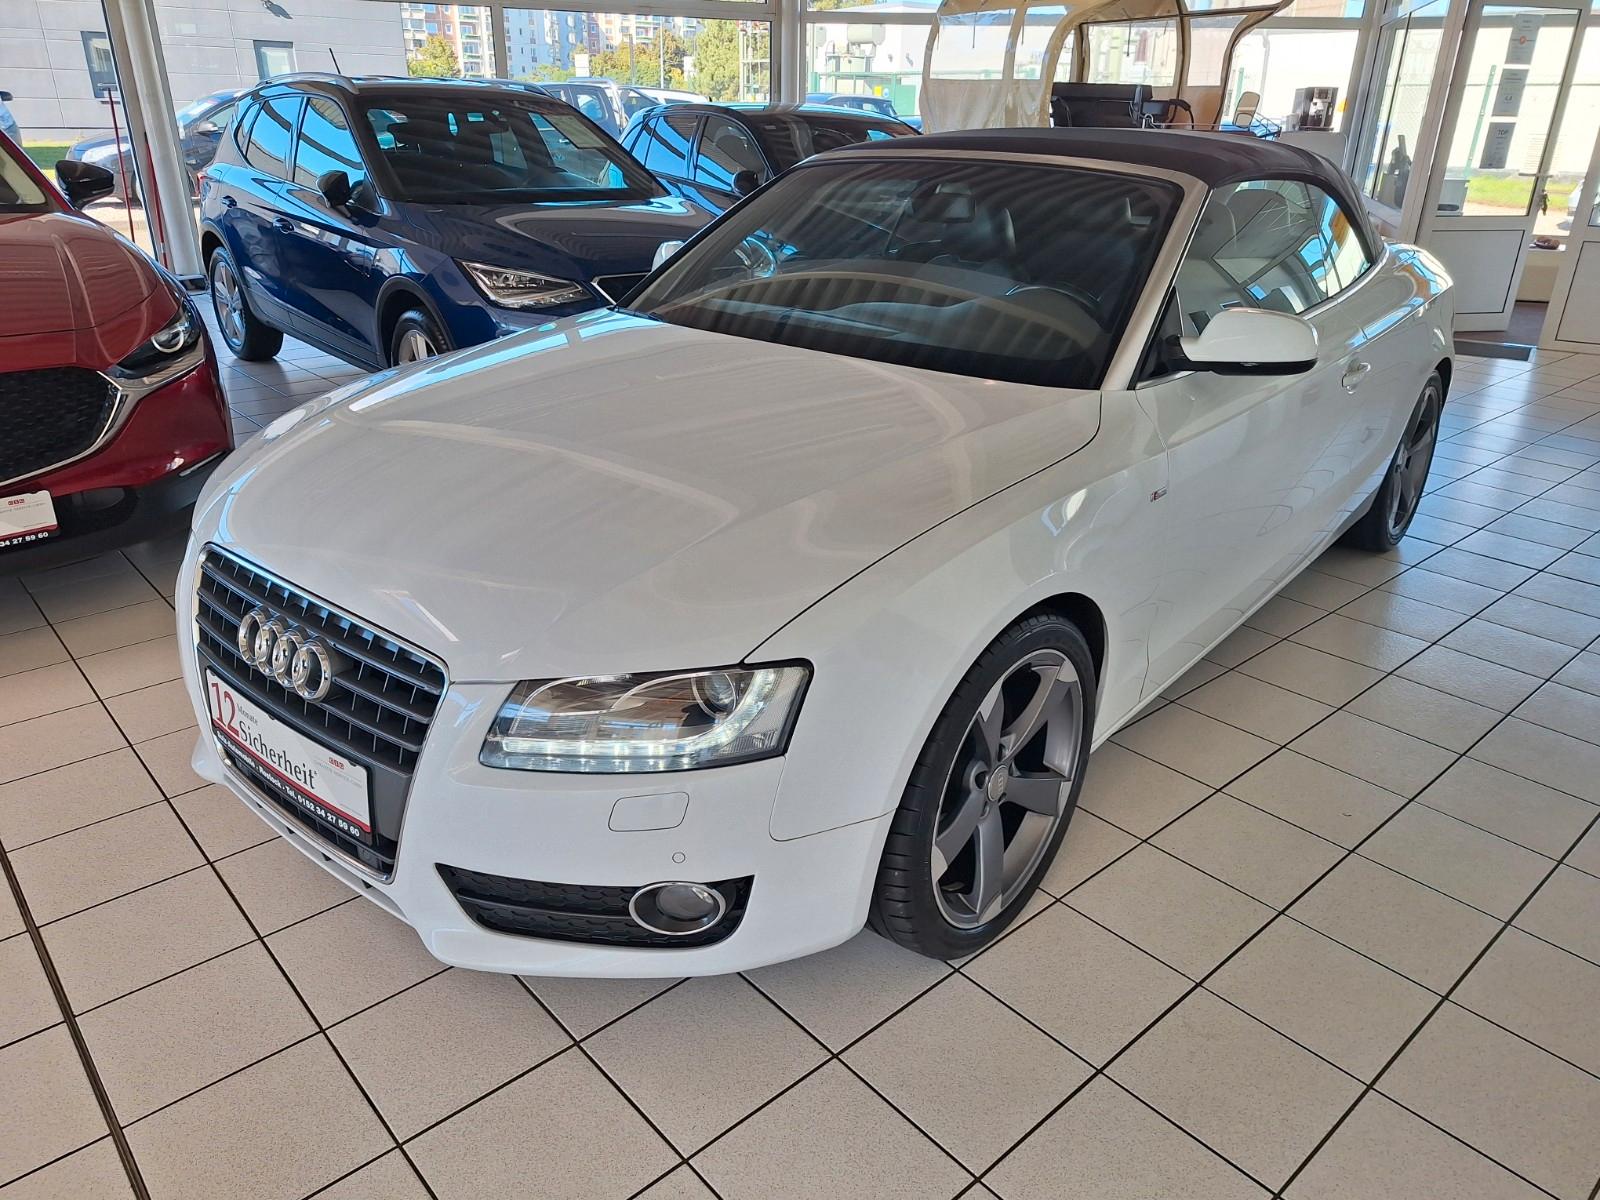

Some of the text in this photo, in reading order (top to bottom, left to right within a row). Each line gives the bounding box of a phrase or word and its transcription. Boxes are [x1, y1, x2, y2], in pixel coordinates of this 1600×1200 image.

[211, 683, 239, 737] 12
[297, 794, 315, 812] 0152
[315, 806, 326, 818] 34
[326, 812, 337, 824] 27
[349, 825, 360, 837] 60
